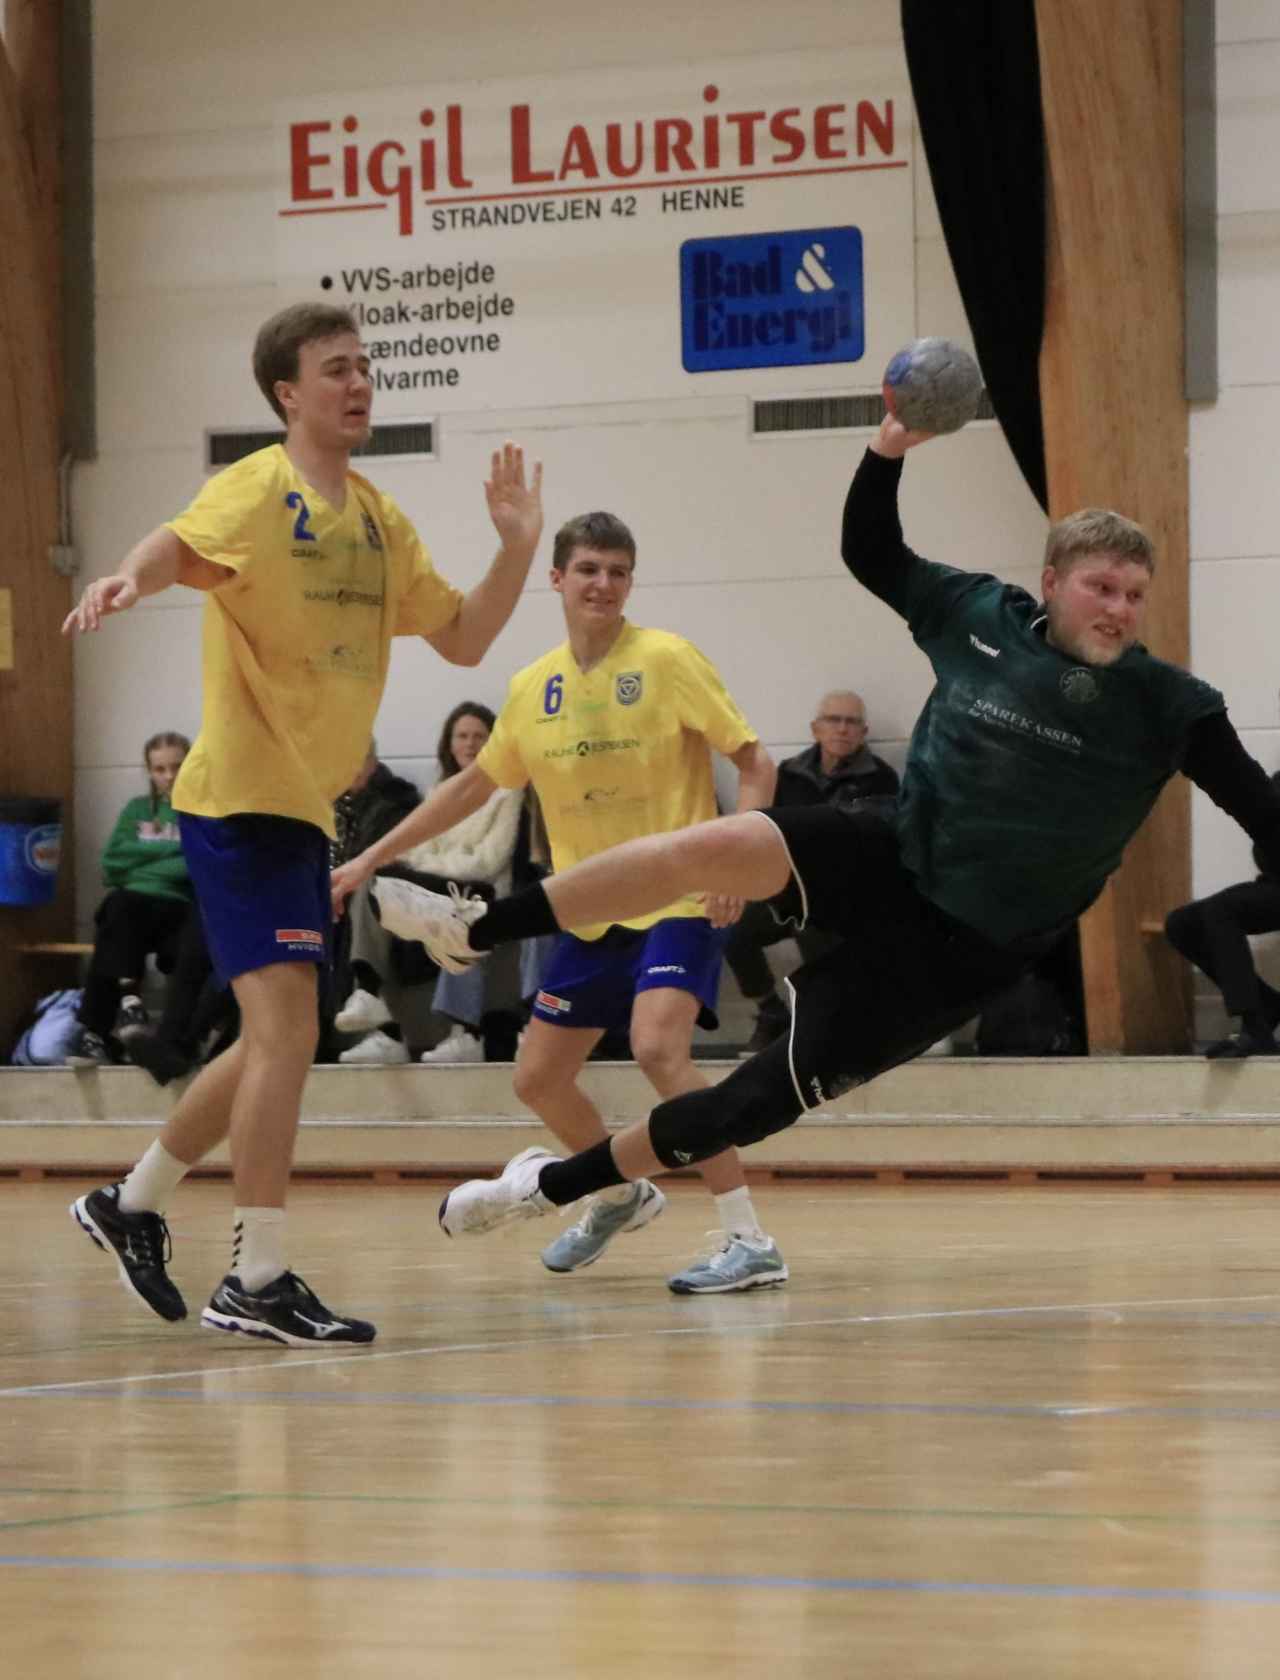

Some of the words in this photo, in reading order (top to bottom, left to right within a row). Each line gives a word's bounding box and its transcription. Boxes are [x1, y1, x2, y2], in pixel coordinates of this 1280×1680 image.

[289, 104, 474, 236] Eigil
[431, 201, 601, 232] STRANDVEJEN
[610, 196, 637, 217] 42
[661, 186, 744, 213] HENNE
[341, 260, 496, 293] VVS-arbejde
[795, 243, 836, 293] &
[285, 491, 316, 541] 2
[544, 673, 564, 715] 6
[974, 699, 1083, 748] SPAREKASSEN
